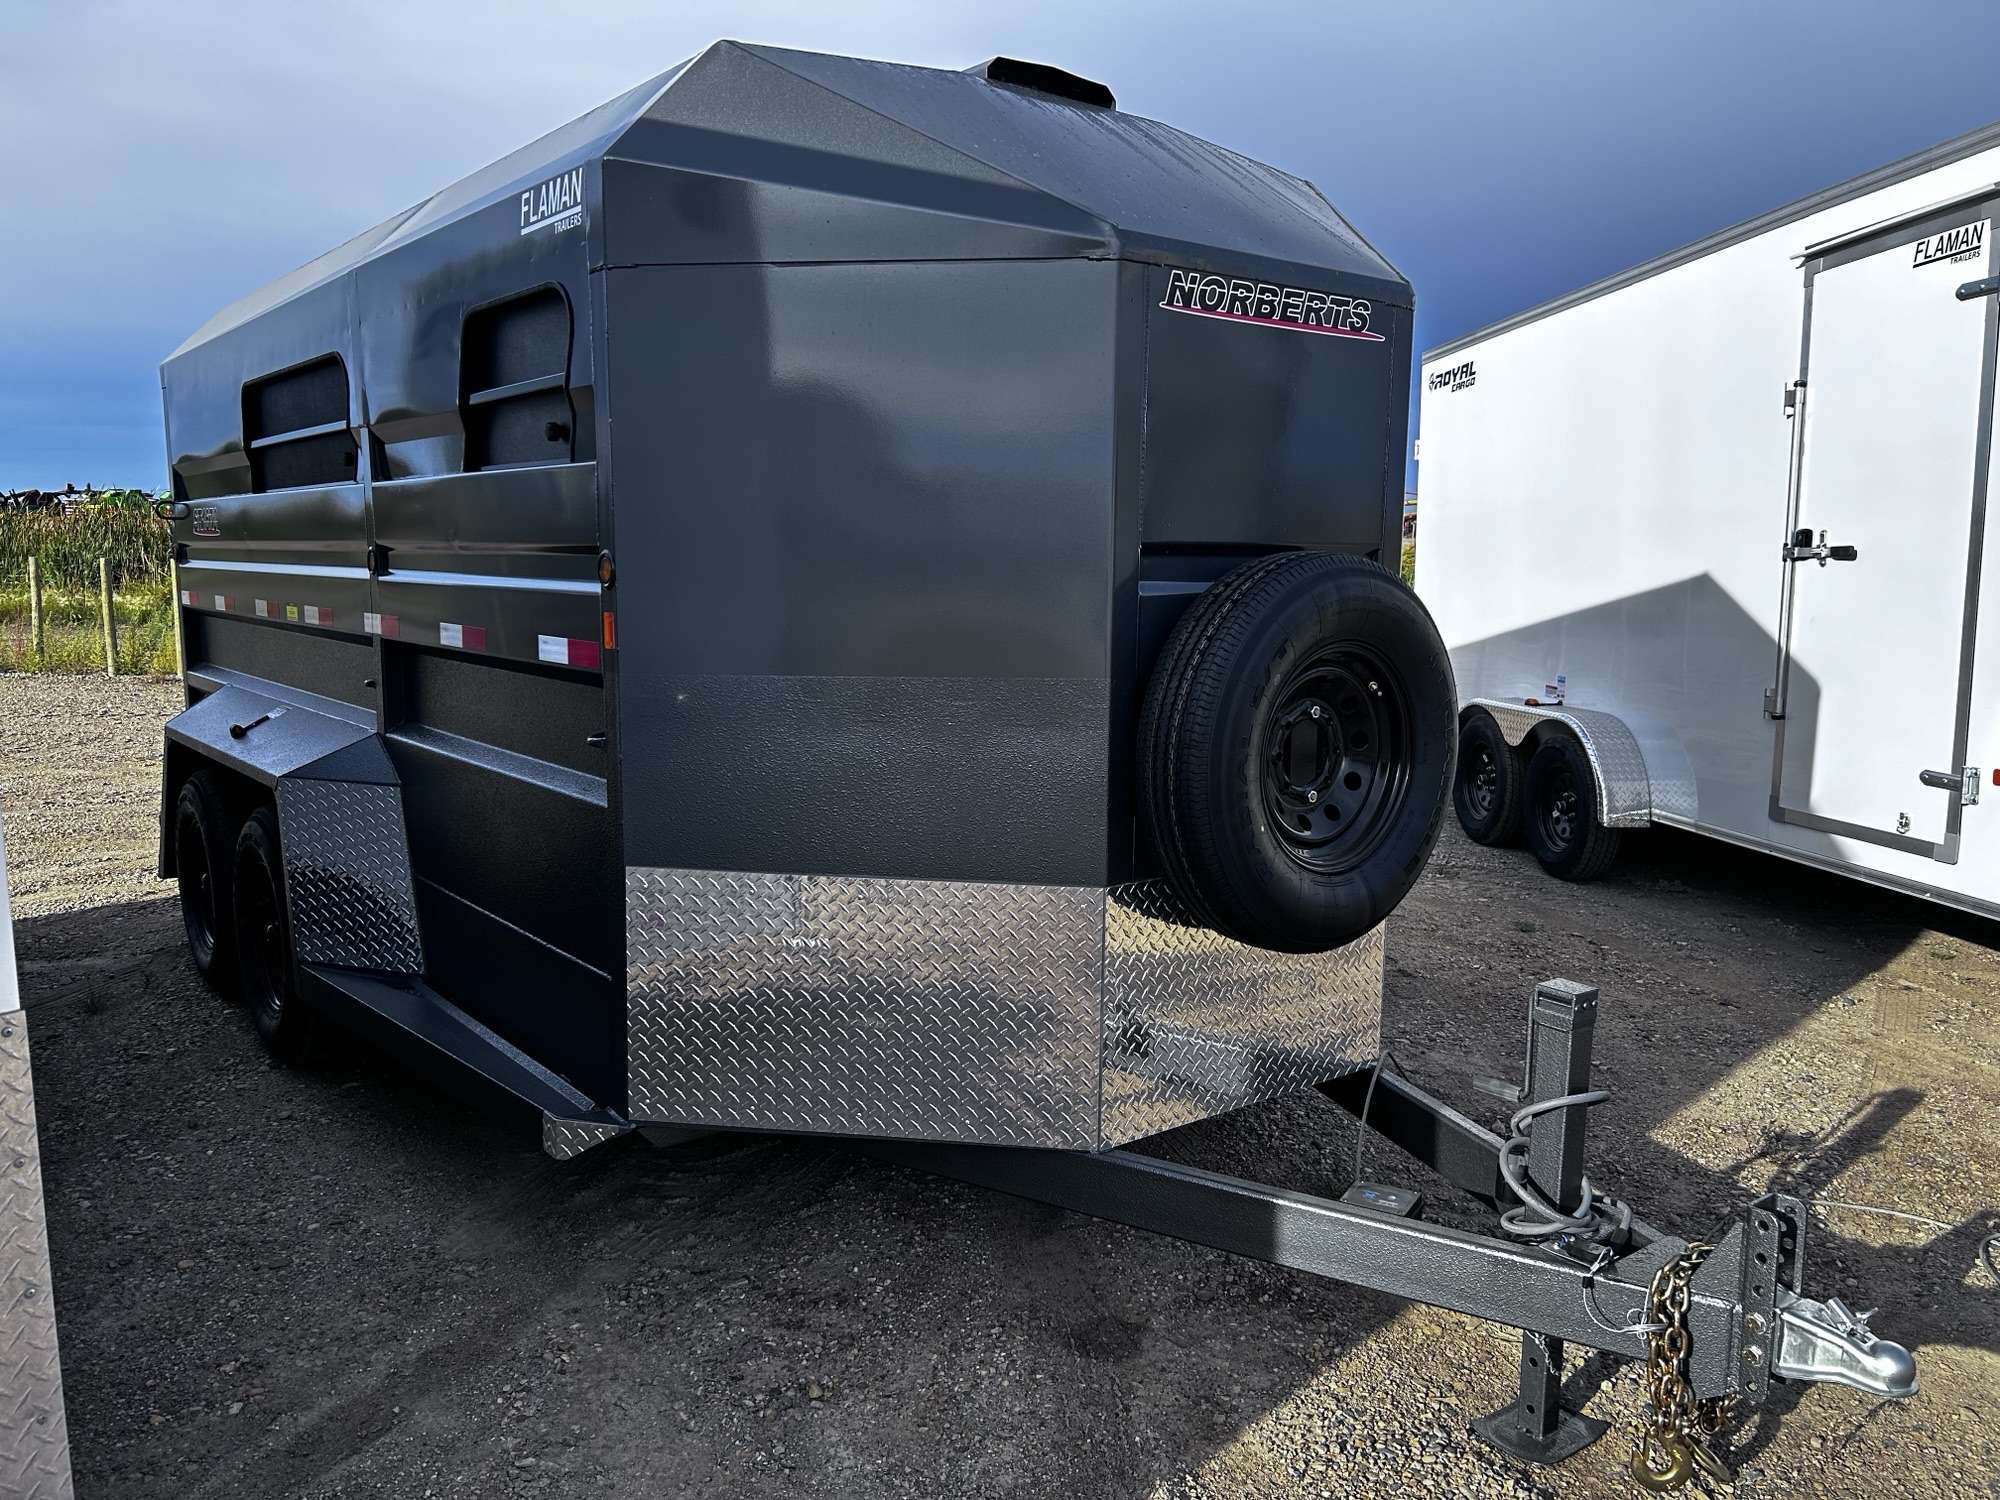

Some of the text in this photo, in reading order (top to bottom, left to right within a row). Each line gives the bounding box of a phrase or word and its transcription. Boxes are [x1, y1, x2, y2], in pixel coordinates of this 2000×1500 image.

[520, 167, 583, 227] FLAMAN
[554, 212, 582, 235] TRAILERS
[1913, 221, 1985, 263] FLAMAN
[1950, 249, 1981, 265] TRAILERS
[1164, 270, 1371, 332] NORBERTS
[1431, 360, 1477, 391] ROYAL
[1451, 376, 1476, 393] CARGO
